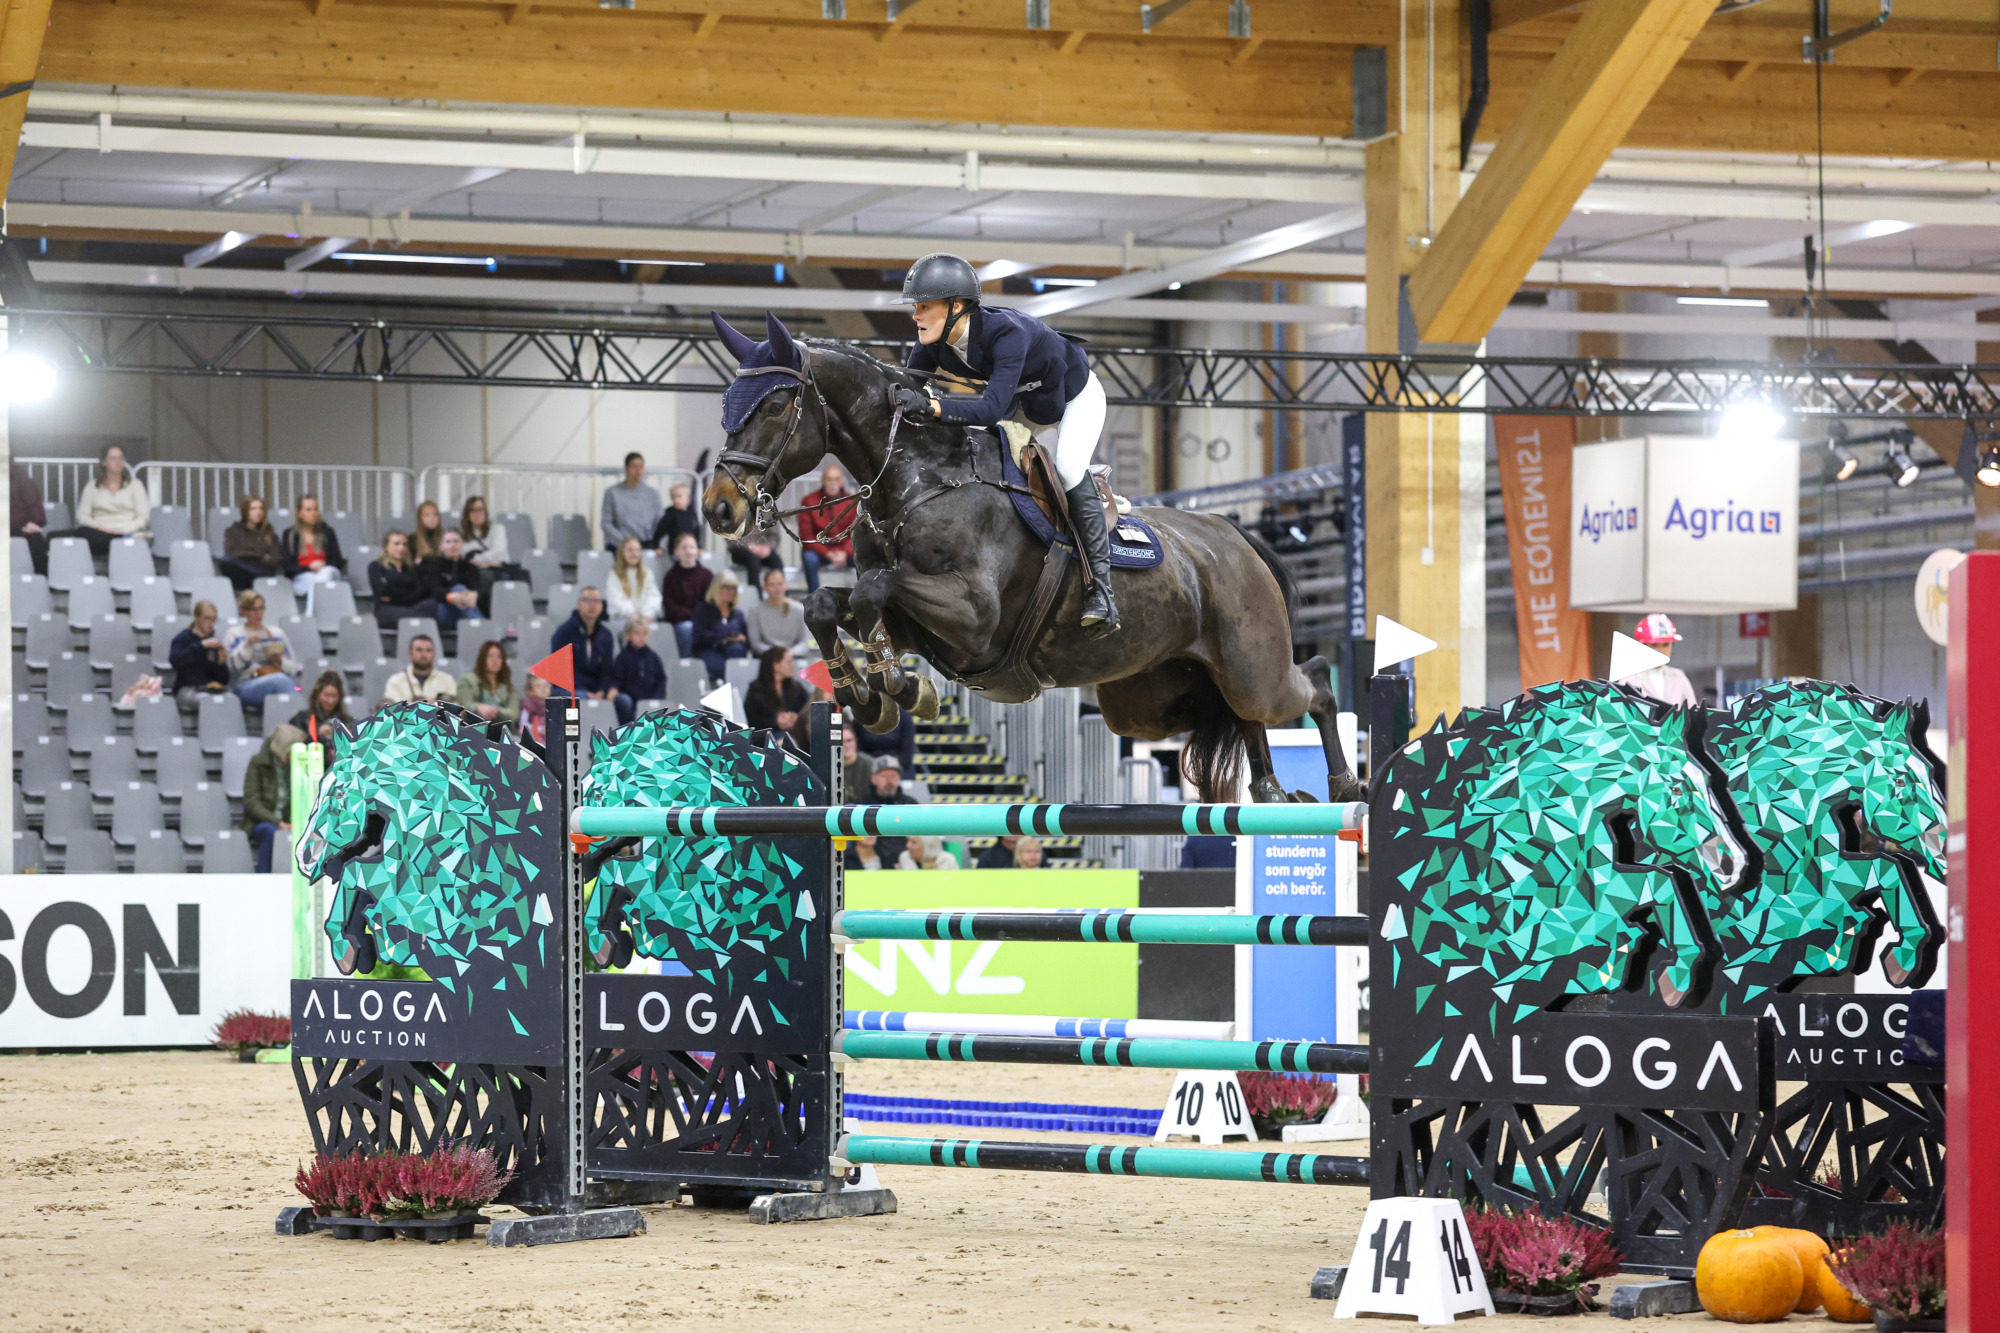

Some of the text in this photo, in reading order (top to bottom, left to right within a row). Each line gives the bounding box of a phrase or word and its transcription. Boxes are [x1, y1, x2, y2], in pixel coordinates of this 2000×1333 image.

[1580, 499, 1624, 543] Agria
[1664, 497, 1754, 539] Agria
[1265, 844, 1326, 858] stunderna
[1265, 862, 1327, 880] som avgör
[1265, 881, 1326, 895] och berör.
[0, 901, 200, 1019] ON
[303, 988, 447, 1023] ALOGA
[600, 990, 763, 1036] LOGA
[1763, 1003, 1909, 1038] ALOG
[325, 1029, 426, 1047] AUCTION
[1787, 1048, 1905, 1067] AUCTIO
[1450, 1033, 1743, 1092] ALOGA
[1175, 1081, 1204, 1126] 10
[1216, 1081, 1241, 1126] 10
[1370, 1218, 1412, 1295] 14
[1440, 1218, 1473, 1294] 14
